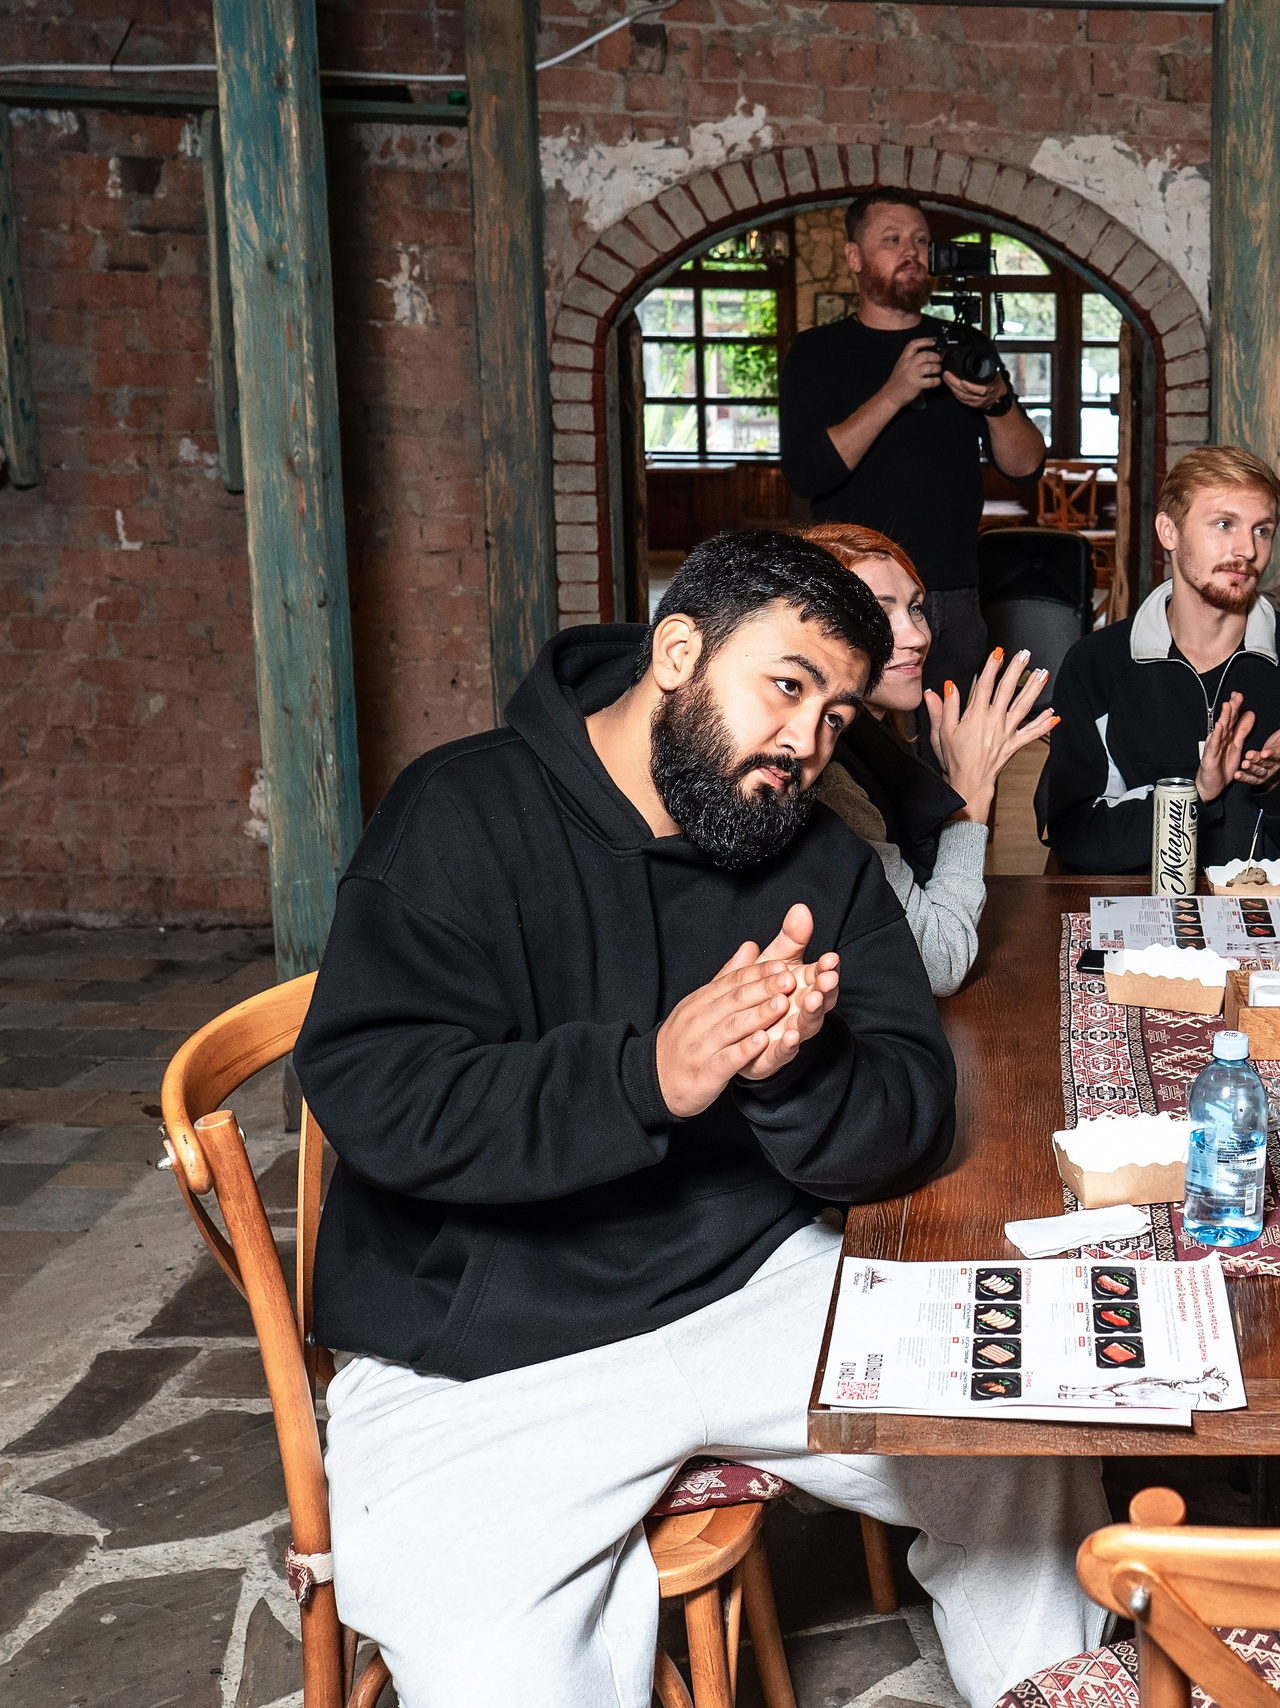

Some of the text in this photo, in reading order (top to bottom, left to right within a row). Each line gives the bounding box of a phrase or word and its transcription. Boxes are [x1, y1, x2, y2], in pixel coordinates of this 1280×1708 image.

[1160, 799, 1191, 895] Жигули
[1174, 1267, 1187, 1322] Южной Америки
[1187, 1267, 1208, 1362] полуфабрикатов из говядины
[1201, 1264, 1220, 1340] Производитель мясных
[839, 1367, 856, 1380] НАС
[864, 1353, 883, 1380] БОЛЬШЕ
